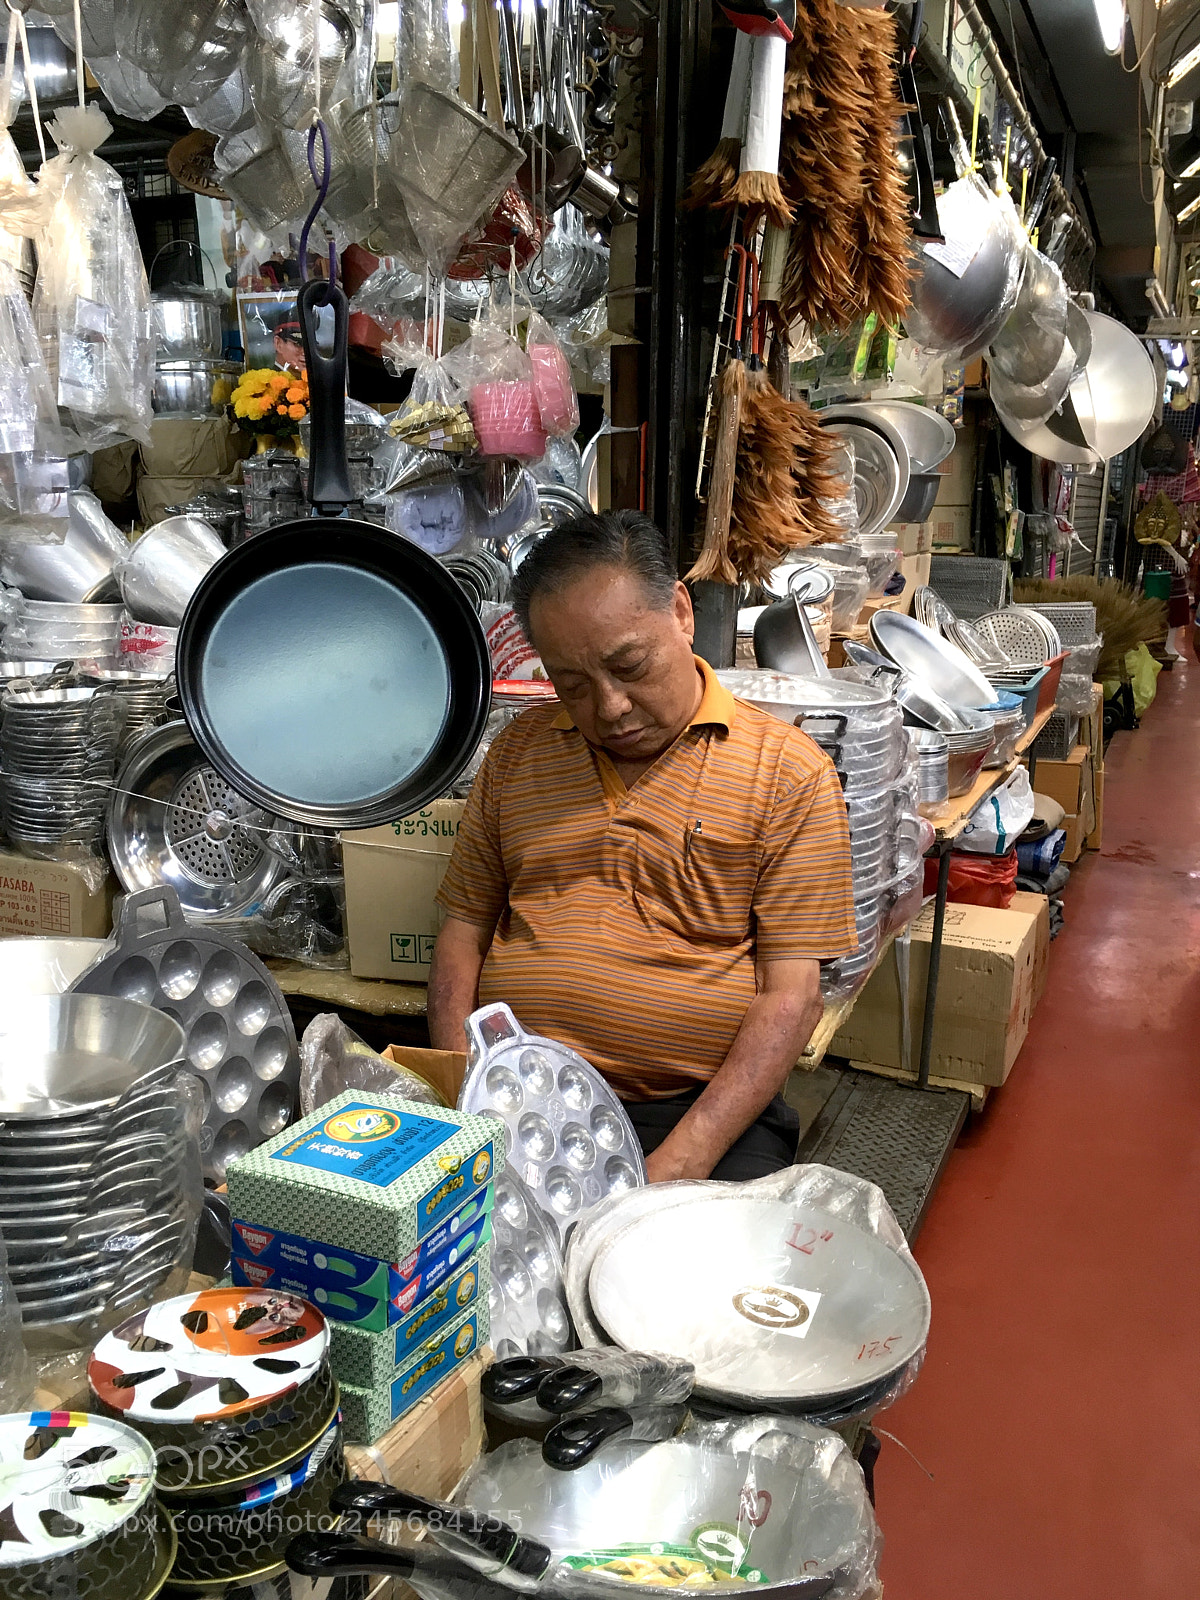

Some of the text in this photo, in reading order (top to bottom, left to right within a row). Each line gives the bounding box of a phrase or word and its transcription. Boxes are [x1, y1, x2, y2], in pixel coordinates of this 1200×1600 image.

[417, 1119, 435, 1130] 12
[242, 1228, 267, 1245] Baygon
[785, 1222, 833, 1255] 12"
[243, 1262, 268, 1279] Baygon
[398, 1251, 418, 1273] Baygon
[398, 1284, 417, 1307] Baygon
